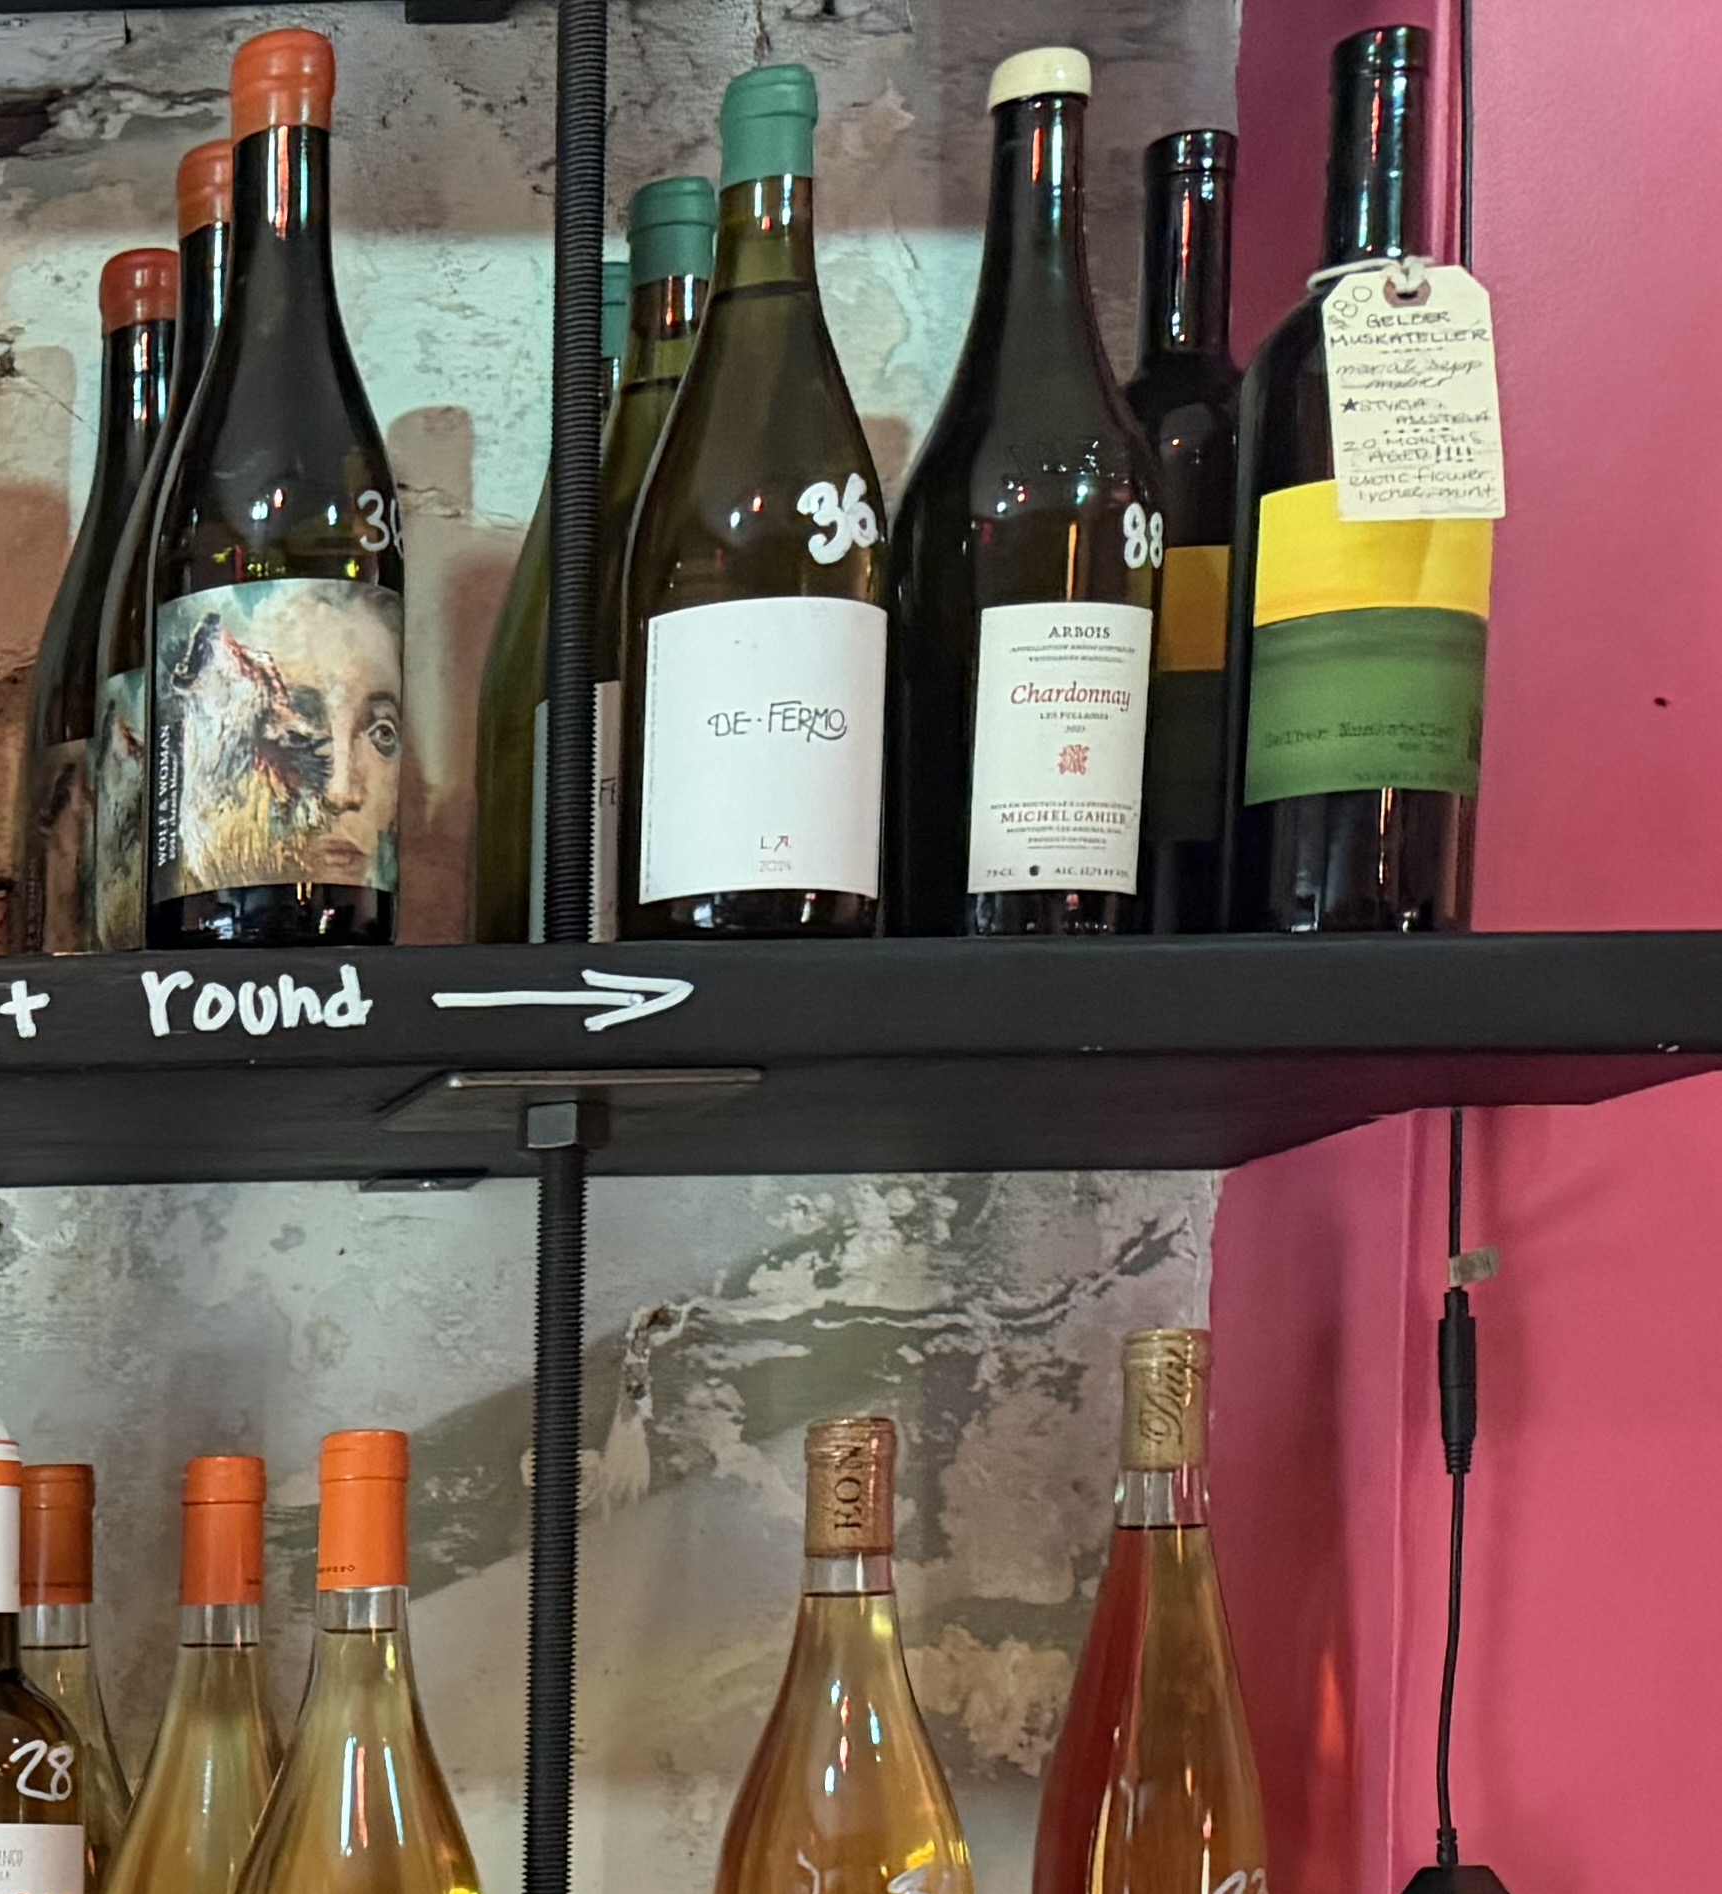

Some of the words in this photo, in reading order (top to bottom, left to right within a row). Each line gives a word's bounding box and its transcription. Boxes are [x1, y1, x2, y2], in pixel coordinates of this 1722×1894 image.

[1330, 328, 1489, 348] MUSKATELLER
[1366, 311, 1451, 329] GELBER
[1048, 626, 1112, 639] ARBOIS
[1009, 681, 1132, 712] Chardonnay
[708, 712, 752, 738] DE
[768, 700, 848, 743] FERMO
[158, 724, 171, 797] WOMAN
[1000, 810, 1069, 824] MICHEL
[1074, 810, 1127, 825] GAHIER
[157, 817, 168, 867] WOLF
[0, 981, 51, 1039] +
[142, 965, 374, 1038] round
[9, 1738, 74, 1801] 28
